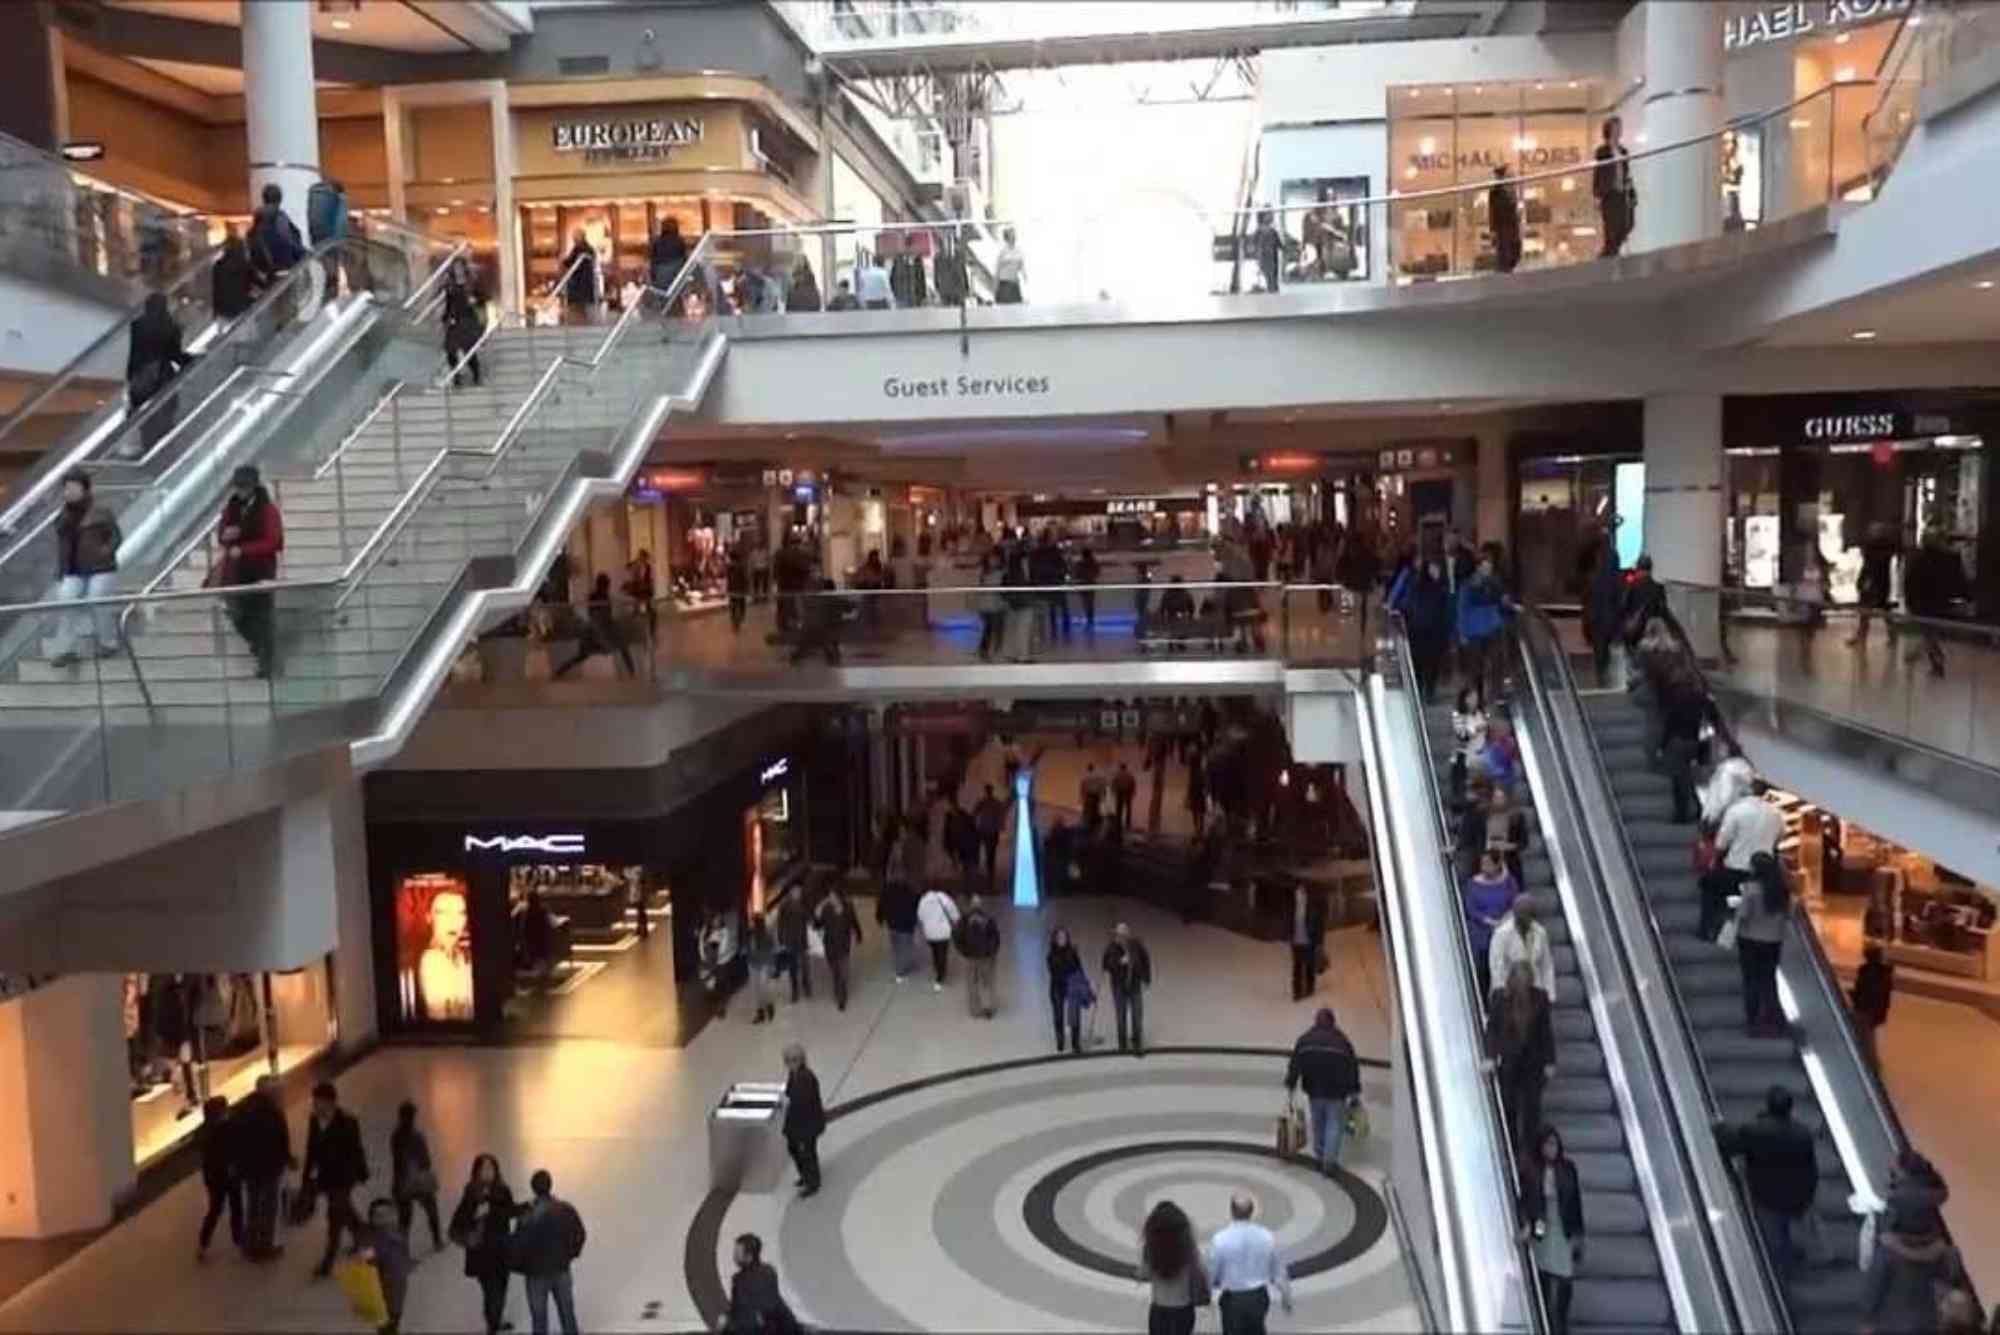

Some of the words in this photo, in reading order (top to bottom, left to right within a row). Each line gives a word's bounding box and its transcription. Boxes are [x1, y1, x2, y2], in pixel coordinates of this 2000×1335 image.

[553, 116, 705, 150] EUROPEAN
[883, 377, 948, 398] Guest
[957, 375, 1050, 396] Services
[1805, 414, 1893, 438] GUESS
[465, 834, 585, 852] MAC
